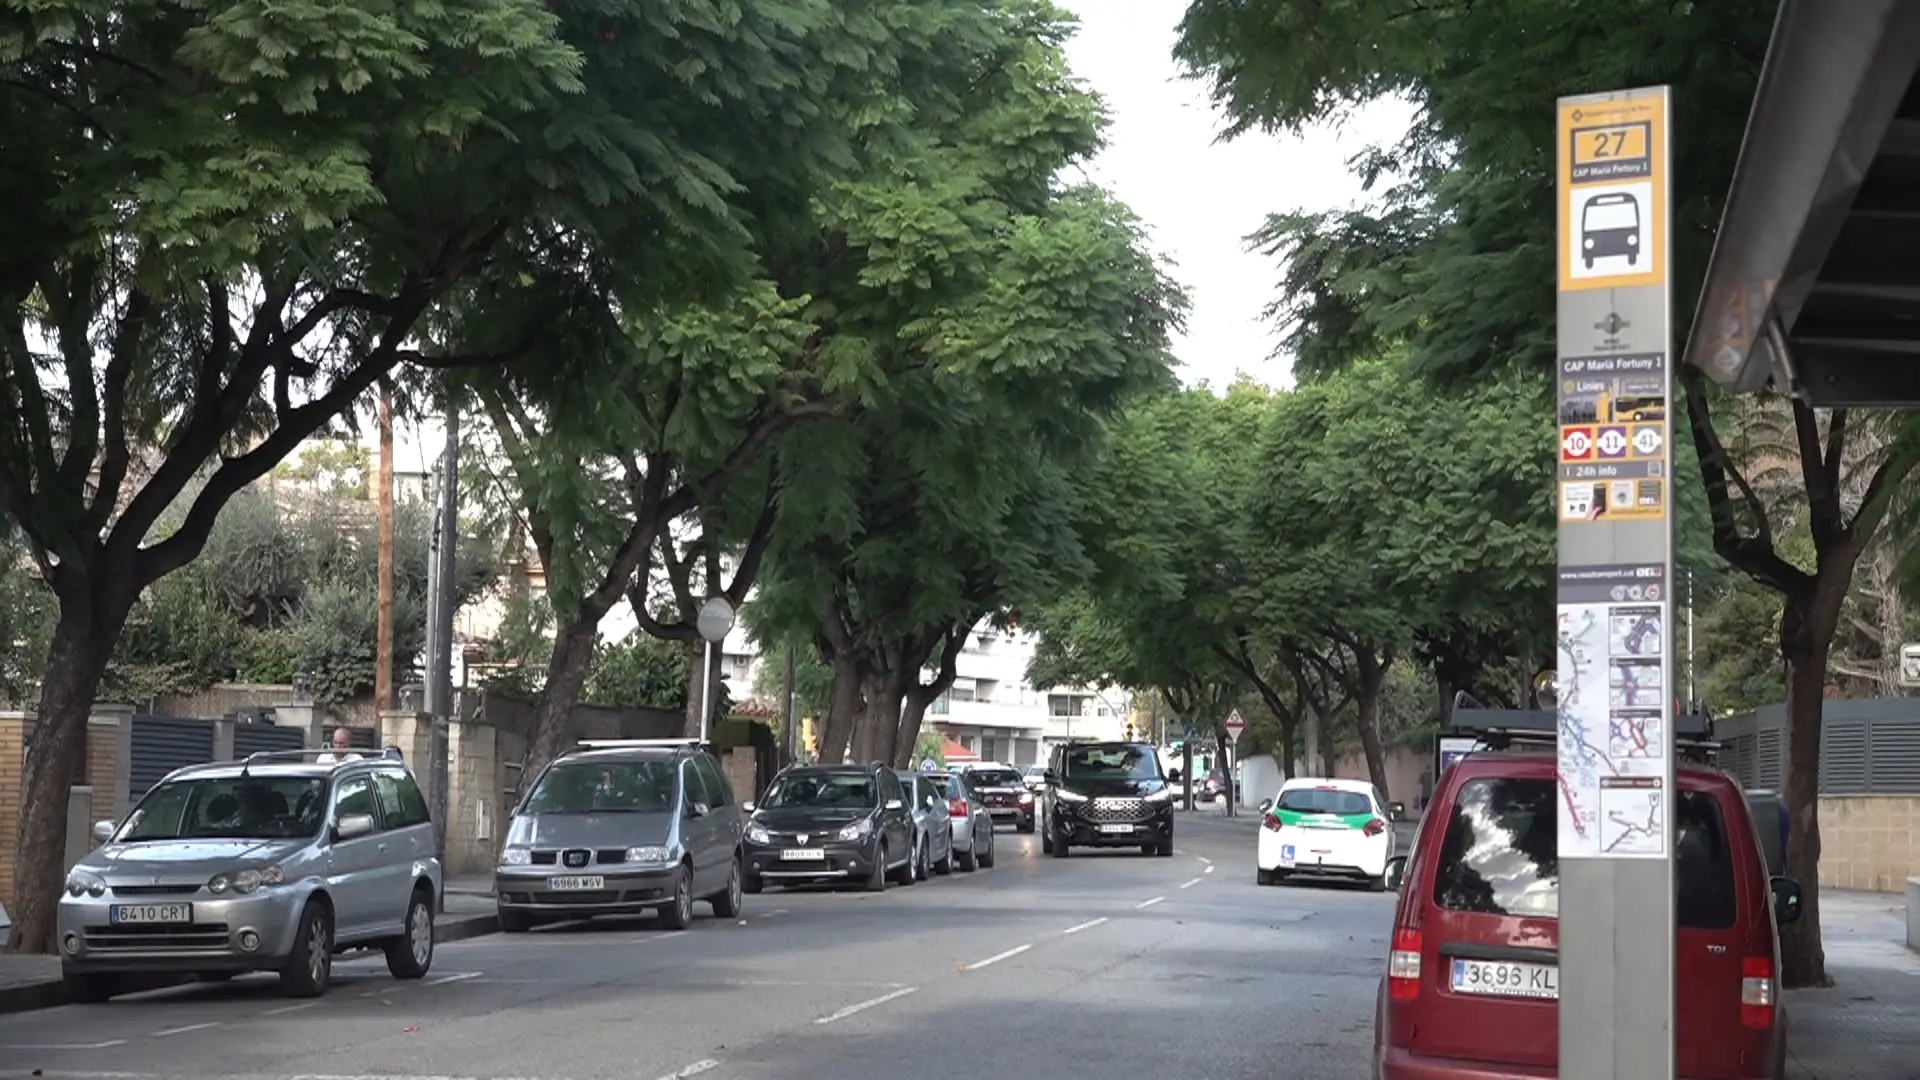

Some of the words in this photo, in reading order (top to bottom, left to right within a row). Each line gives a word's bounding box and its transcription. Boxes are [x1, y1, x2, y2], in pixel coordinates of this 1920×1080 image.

[1594, 131, 1627, 157] 27
[1573, 167, 1589, 178] CAP
[1613, 164, 1641, 173] Fortuny
[1643, 161, 1647, 171] 1
[1564, 360, 1584, 373] CAP
[1616, 358, 1653, 370] Fortuny
[1656, 356, 1661, 368] 1
[1570, 438, 1584, 450] 10
[1606, 436, 1618, 449] 11
[1640, 434, 1653, 448] 41
[1576, 466, 1596, 477] 24h
[1598, 464, 1617, 476] info
[120, 907, 156, 921] 6410
[160, 905, 186, 920] CRT
[1468, 963, 1522, 986] 3696
[1530, 968, 1556, 989] KL
